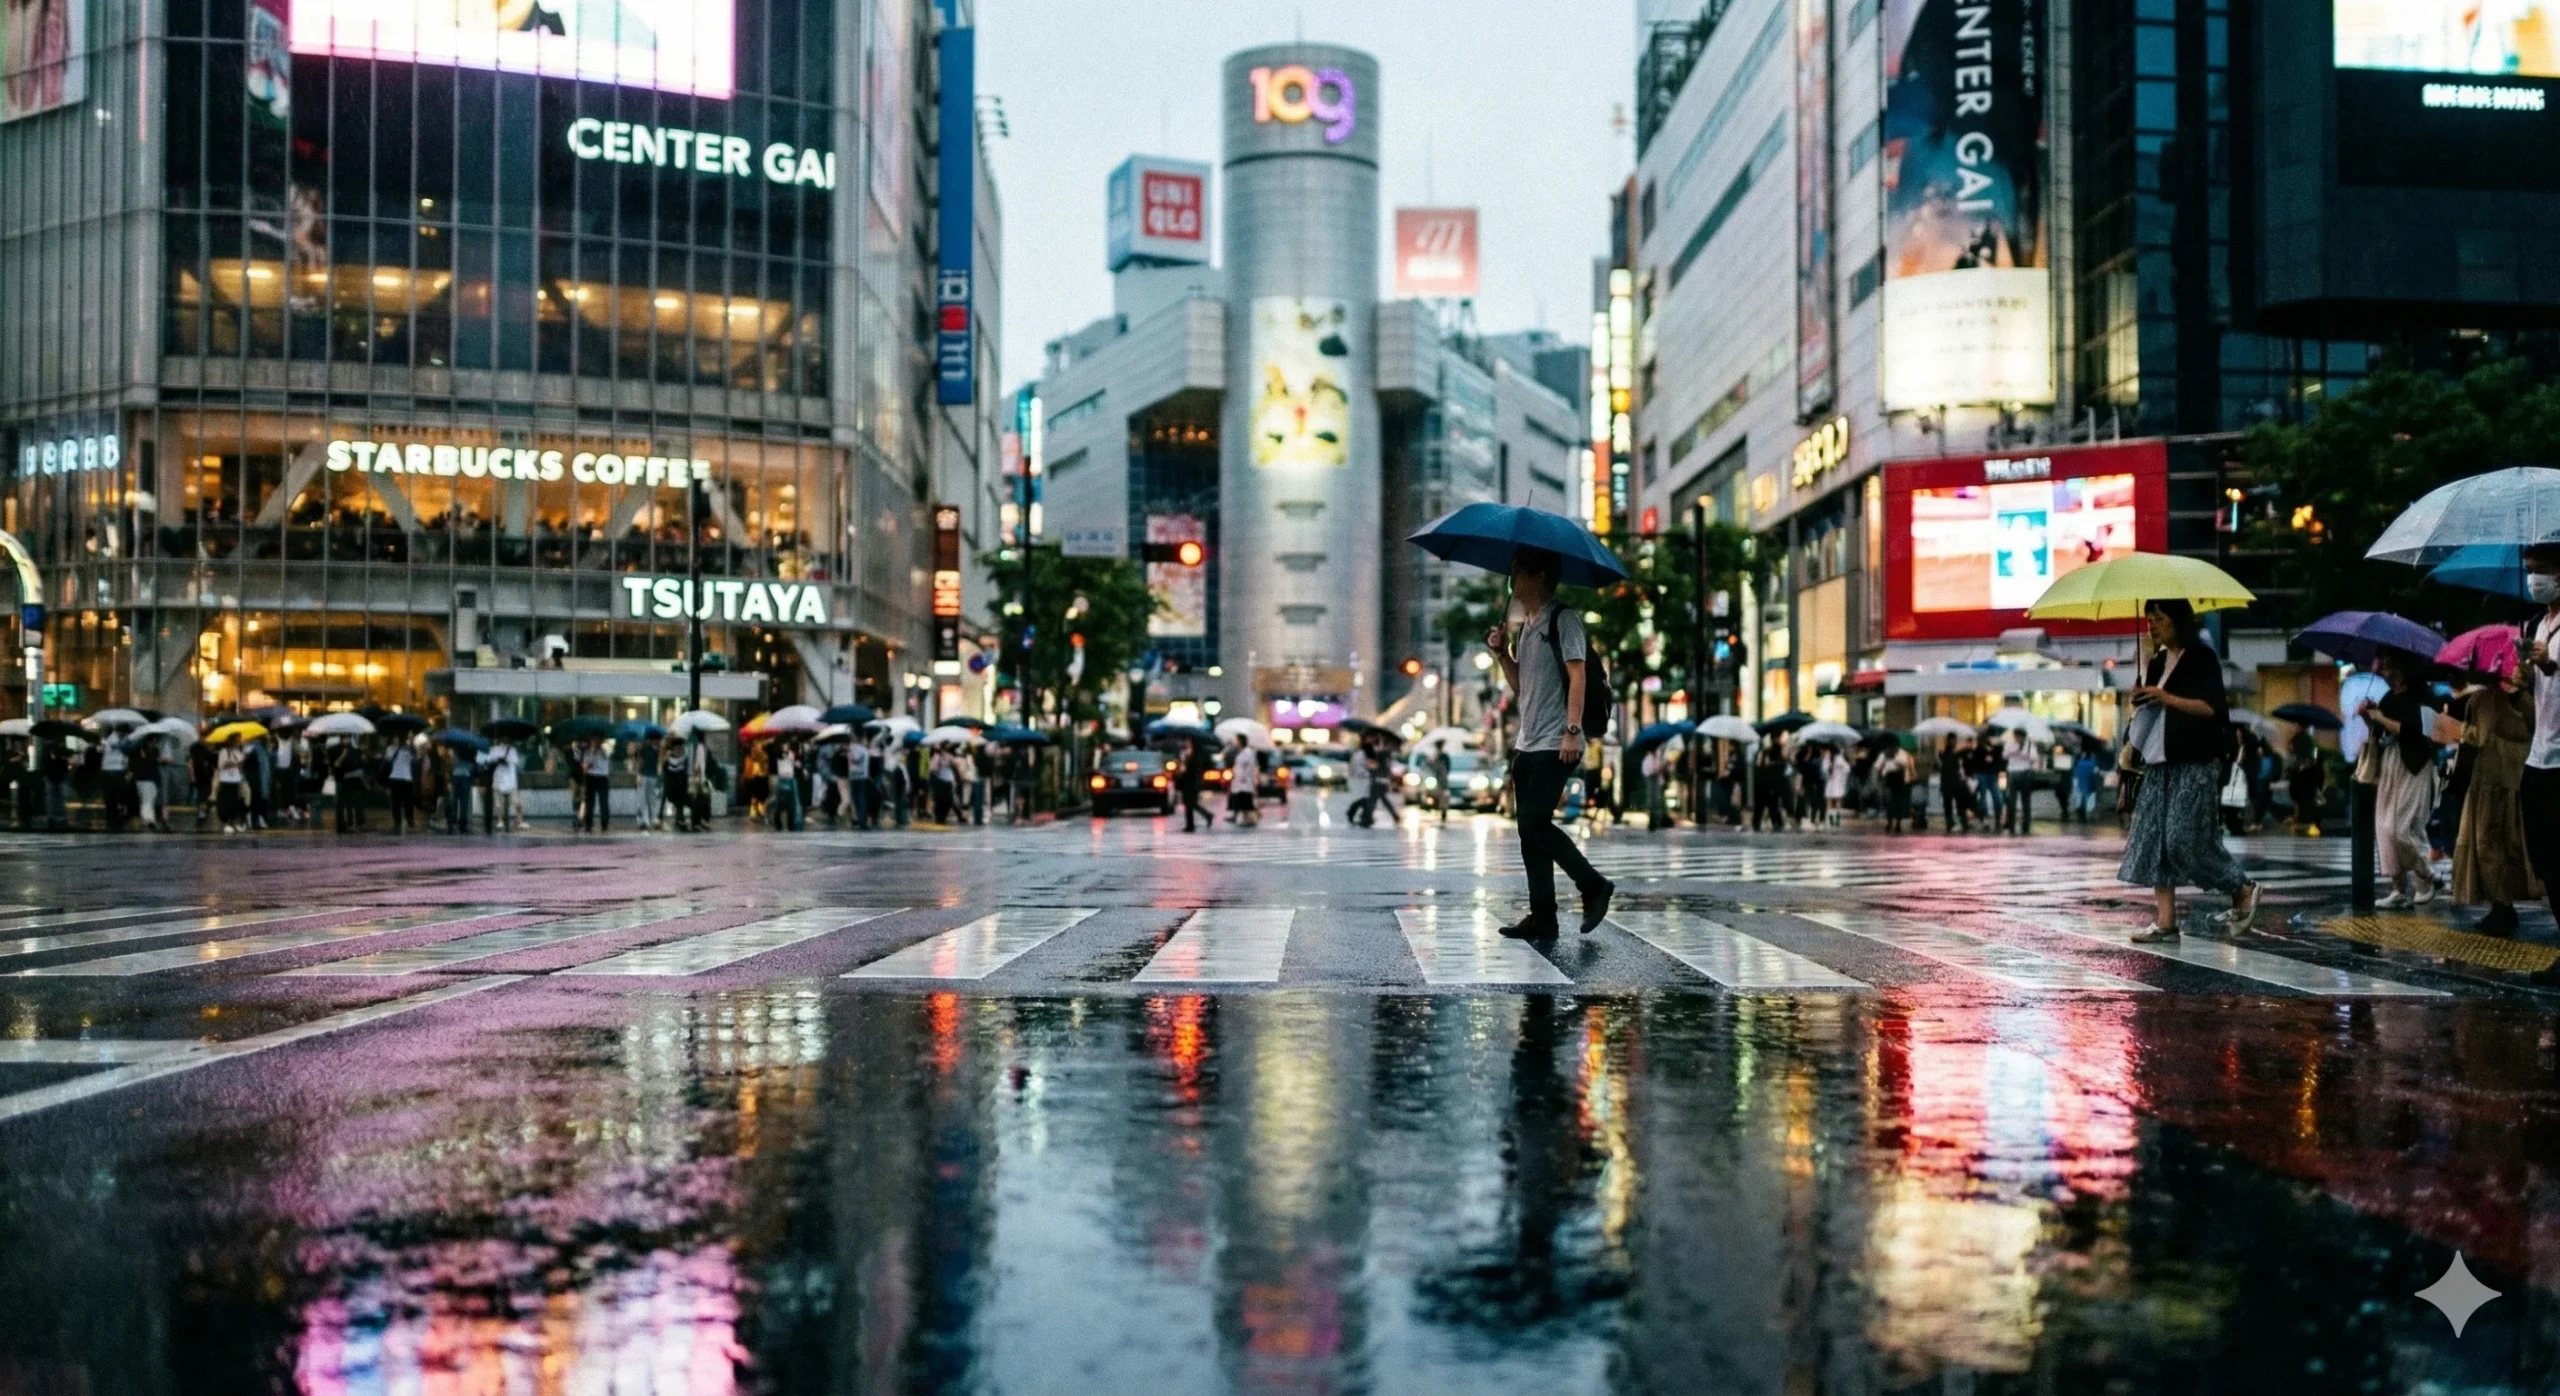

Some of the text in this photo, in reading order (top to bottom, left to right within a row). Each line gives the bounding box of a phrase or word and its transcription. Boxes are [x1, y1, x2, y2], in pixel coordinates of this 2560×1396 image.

[1249, 65, 1355, 142] 109
[1955, 0, 1994, 211] NTER GAI
[567, 117, 836, 190] CENTER GAI
[326, 441, 564, 481] STARBUCKS
[622, 576, 827, 624] TSUTAYA
